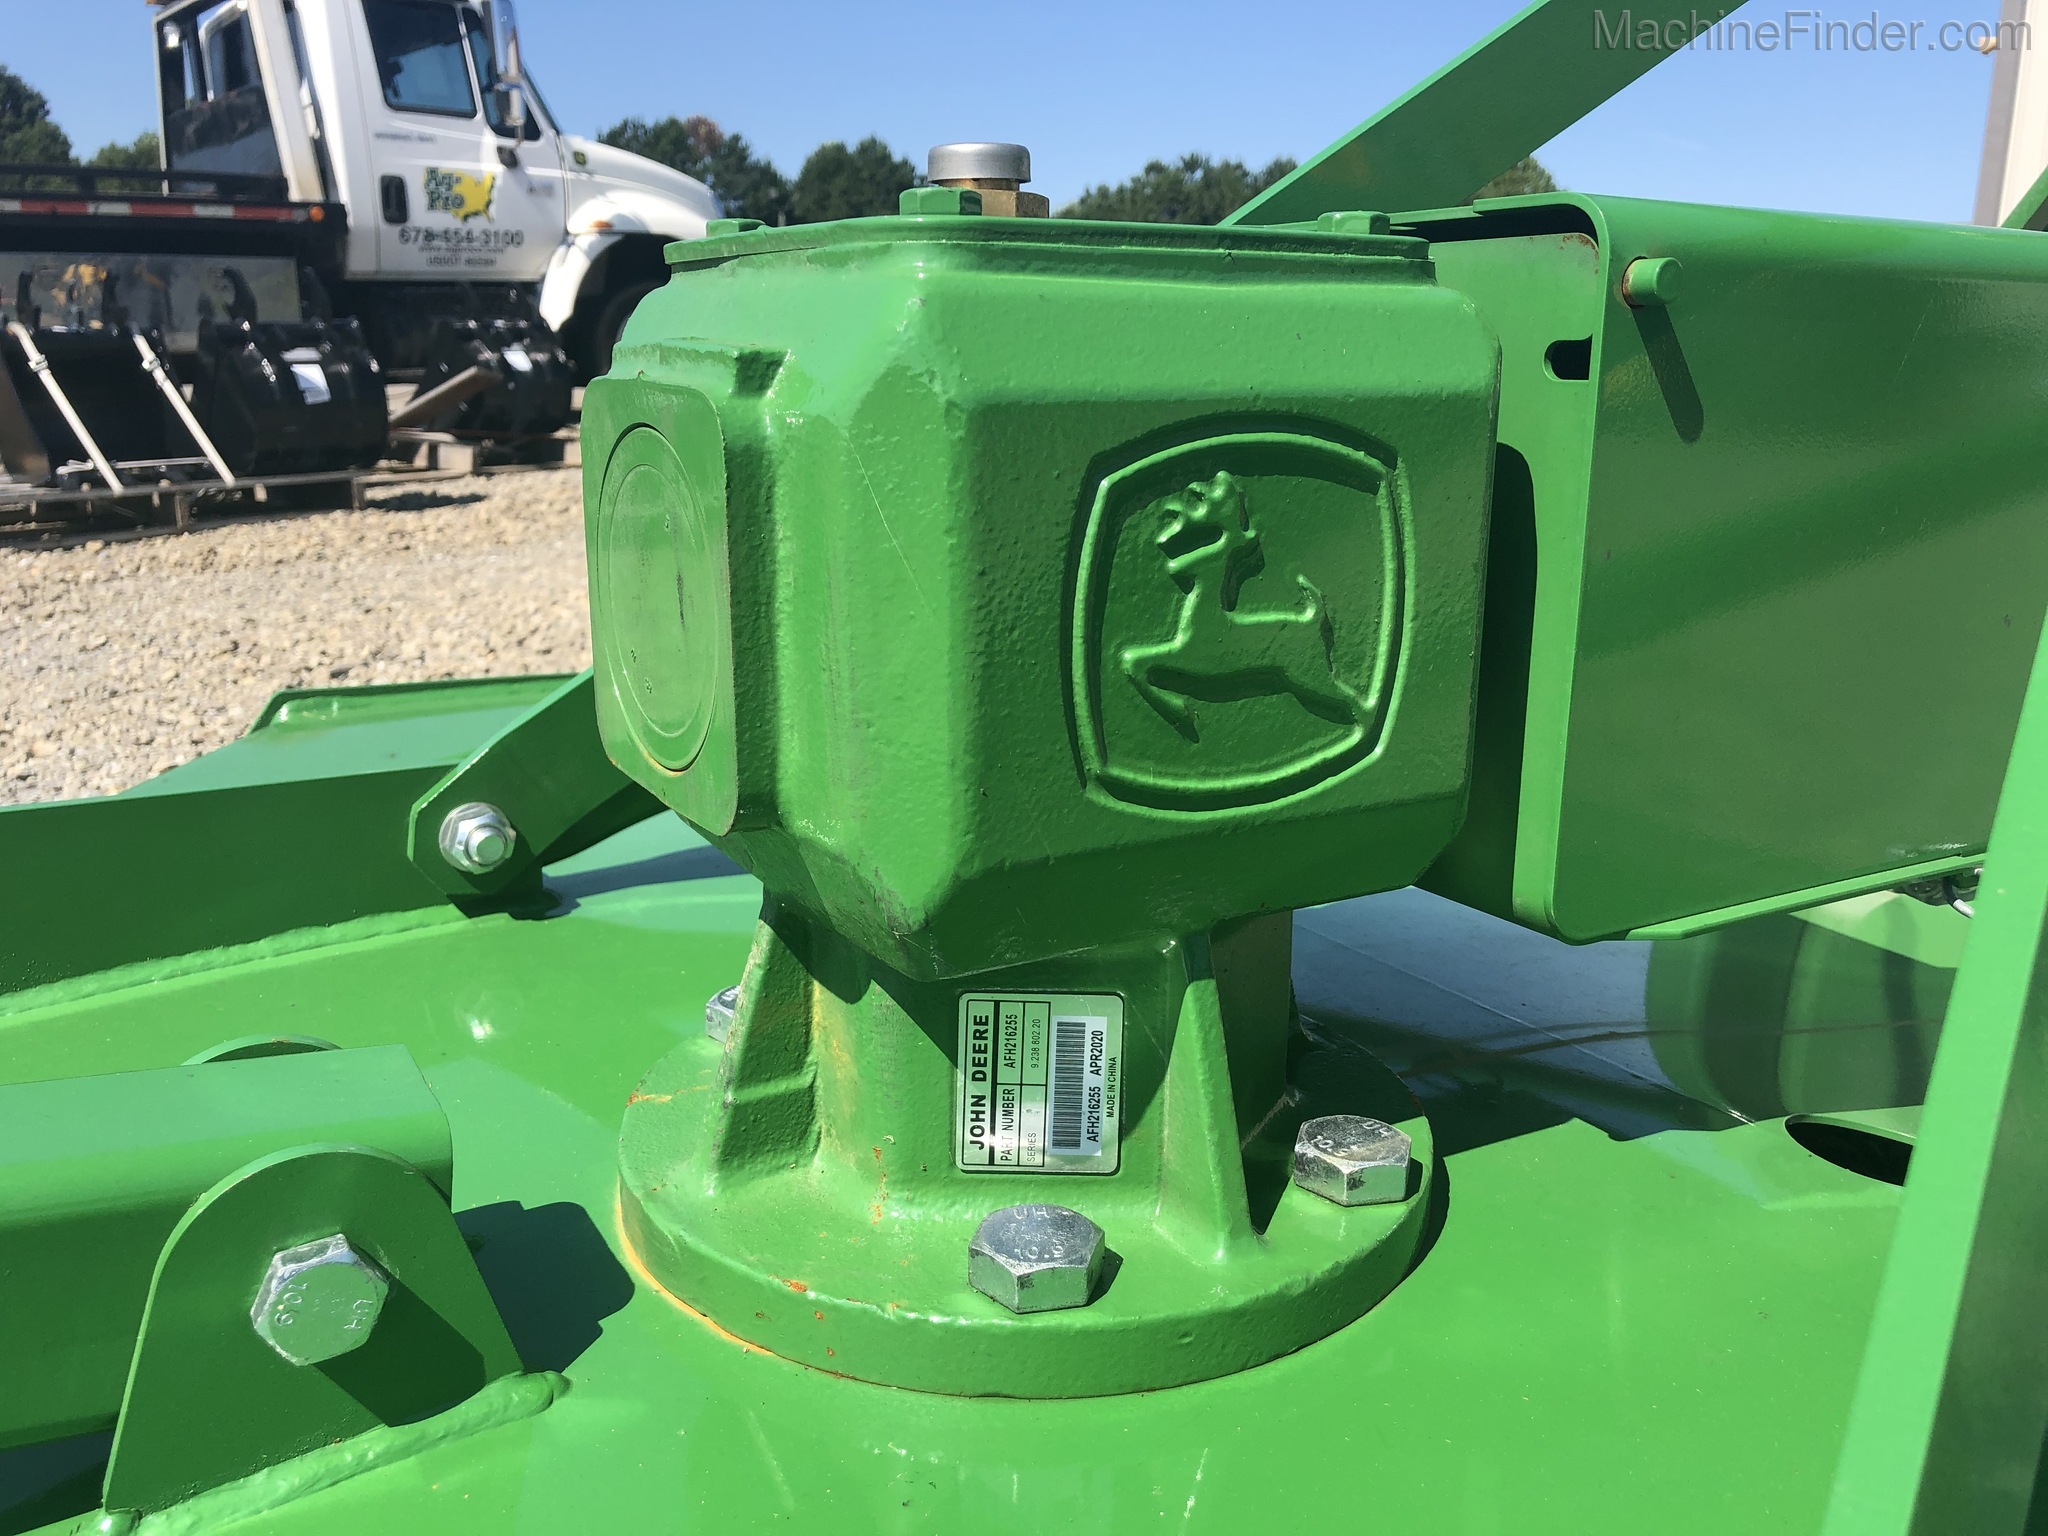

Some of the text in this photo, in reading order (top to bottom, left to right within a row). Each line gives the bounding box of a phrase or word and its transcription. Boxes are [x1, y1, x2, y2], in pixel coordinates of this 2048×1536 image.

[1003, 1013, 1018, 1069] AFH216255
[969, 1014, 989, 1150] JOHN DEERE
[1087, 1030, 1104, 1142] AFH216255 APR2020
[1106, 1056, 1117, 1118] MADE IN CHINA
[1001, 1088, 1016, 1162] PART NUMBER
[1027, 1132, 1037, 1162] SERIES
